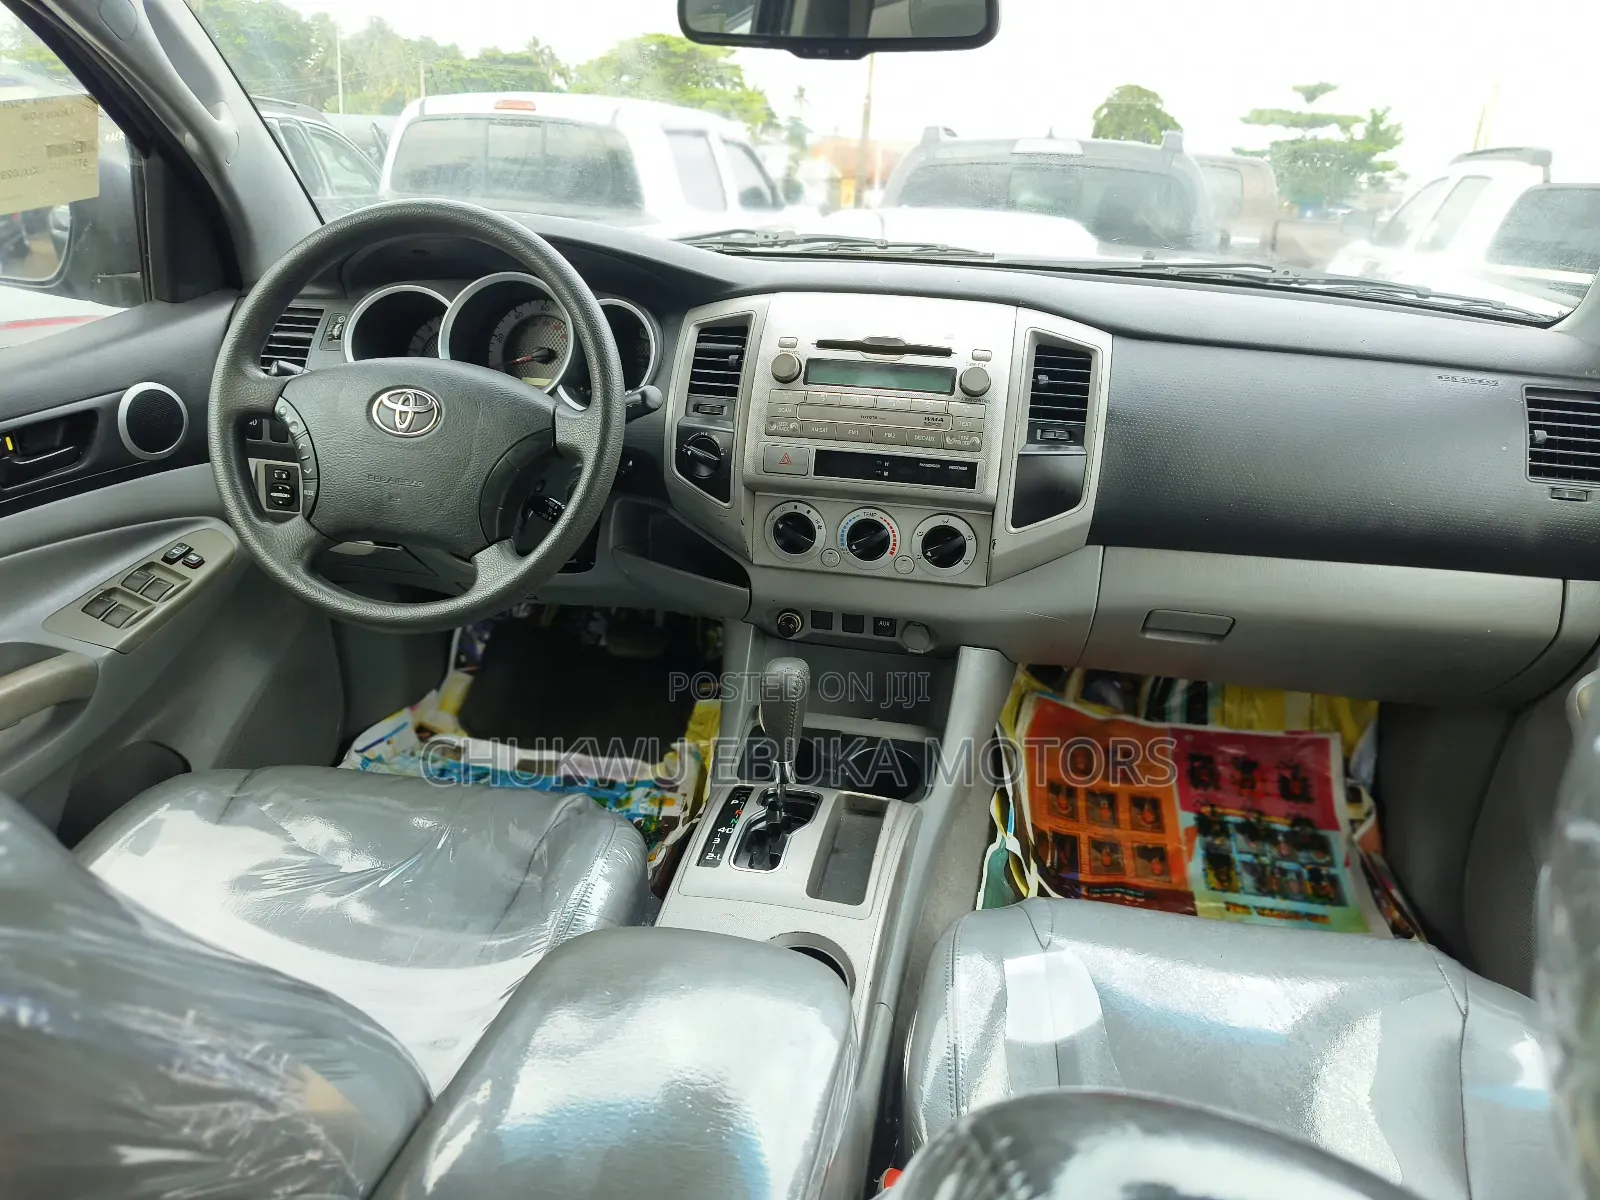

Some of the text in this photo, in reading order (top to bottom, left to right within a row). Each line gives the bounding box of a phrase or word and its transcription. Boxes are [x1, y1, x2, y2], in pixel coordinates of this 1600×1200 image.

[540, 305, 550, 313] 60
[514, 311, 524, 320] 40
[496, 333, 504, 344] 20
